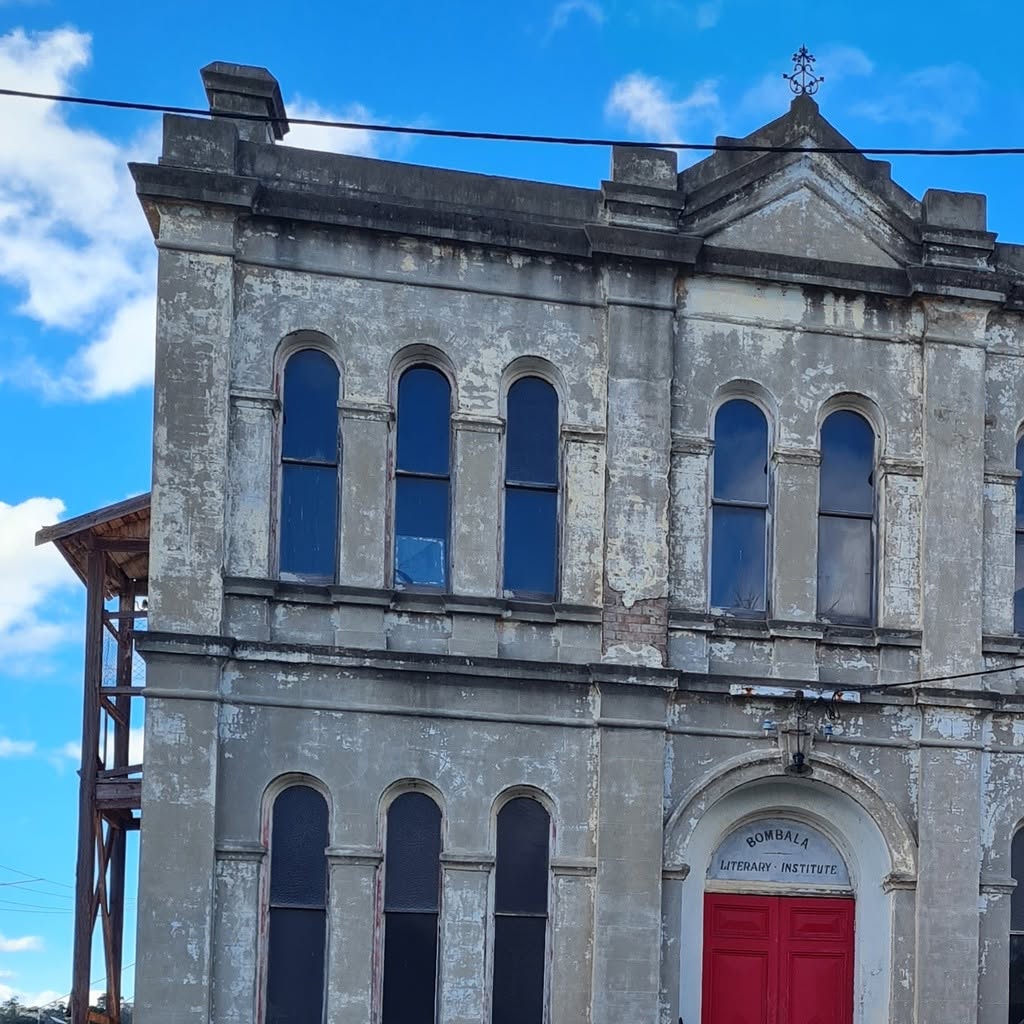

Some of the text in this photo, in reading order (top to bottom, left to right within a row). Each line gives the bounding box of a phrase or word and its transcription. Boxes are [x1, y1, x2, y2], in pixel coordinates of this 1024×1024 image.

[746, 829, 809, 850] BOMBALA
[720, 860, 837, 875] LITERARY INSTITUTE
